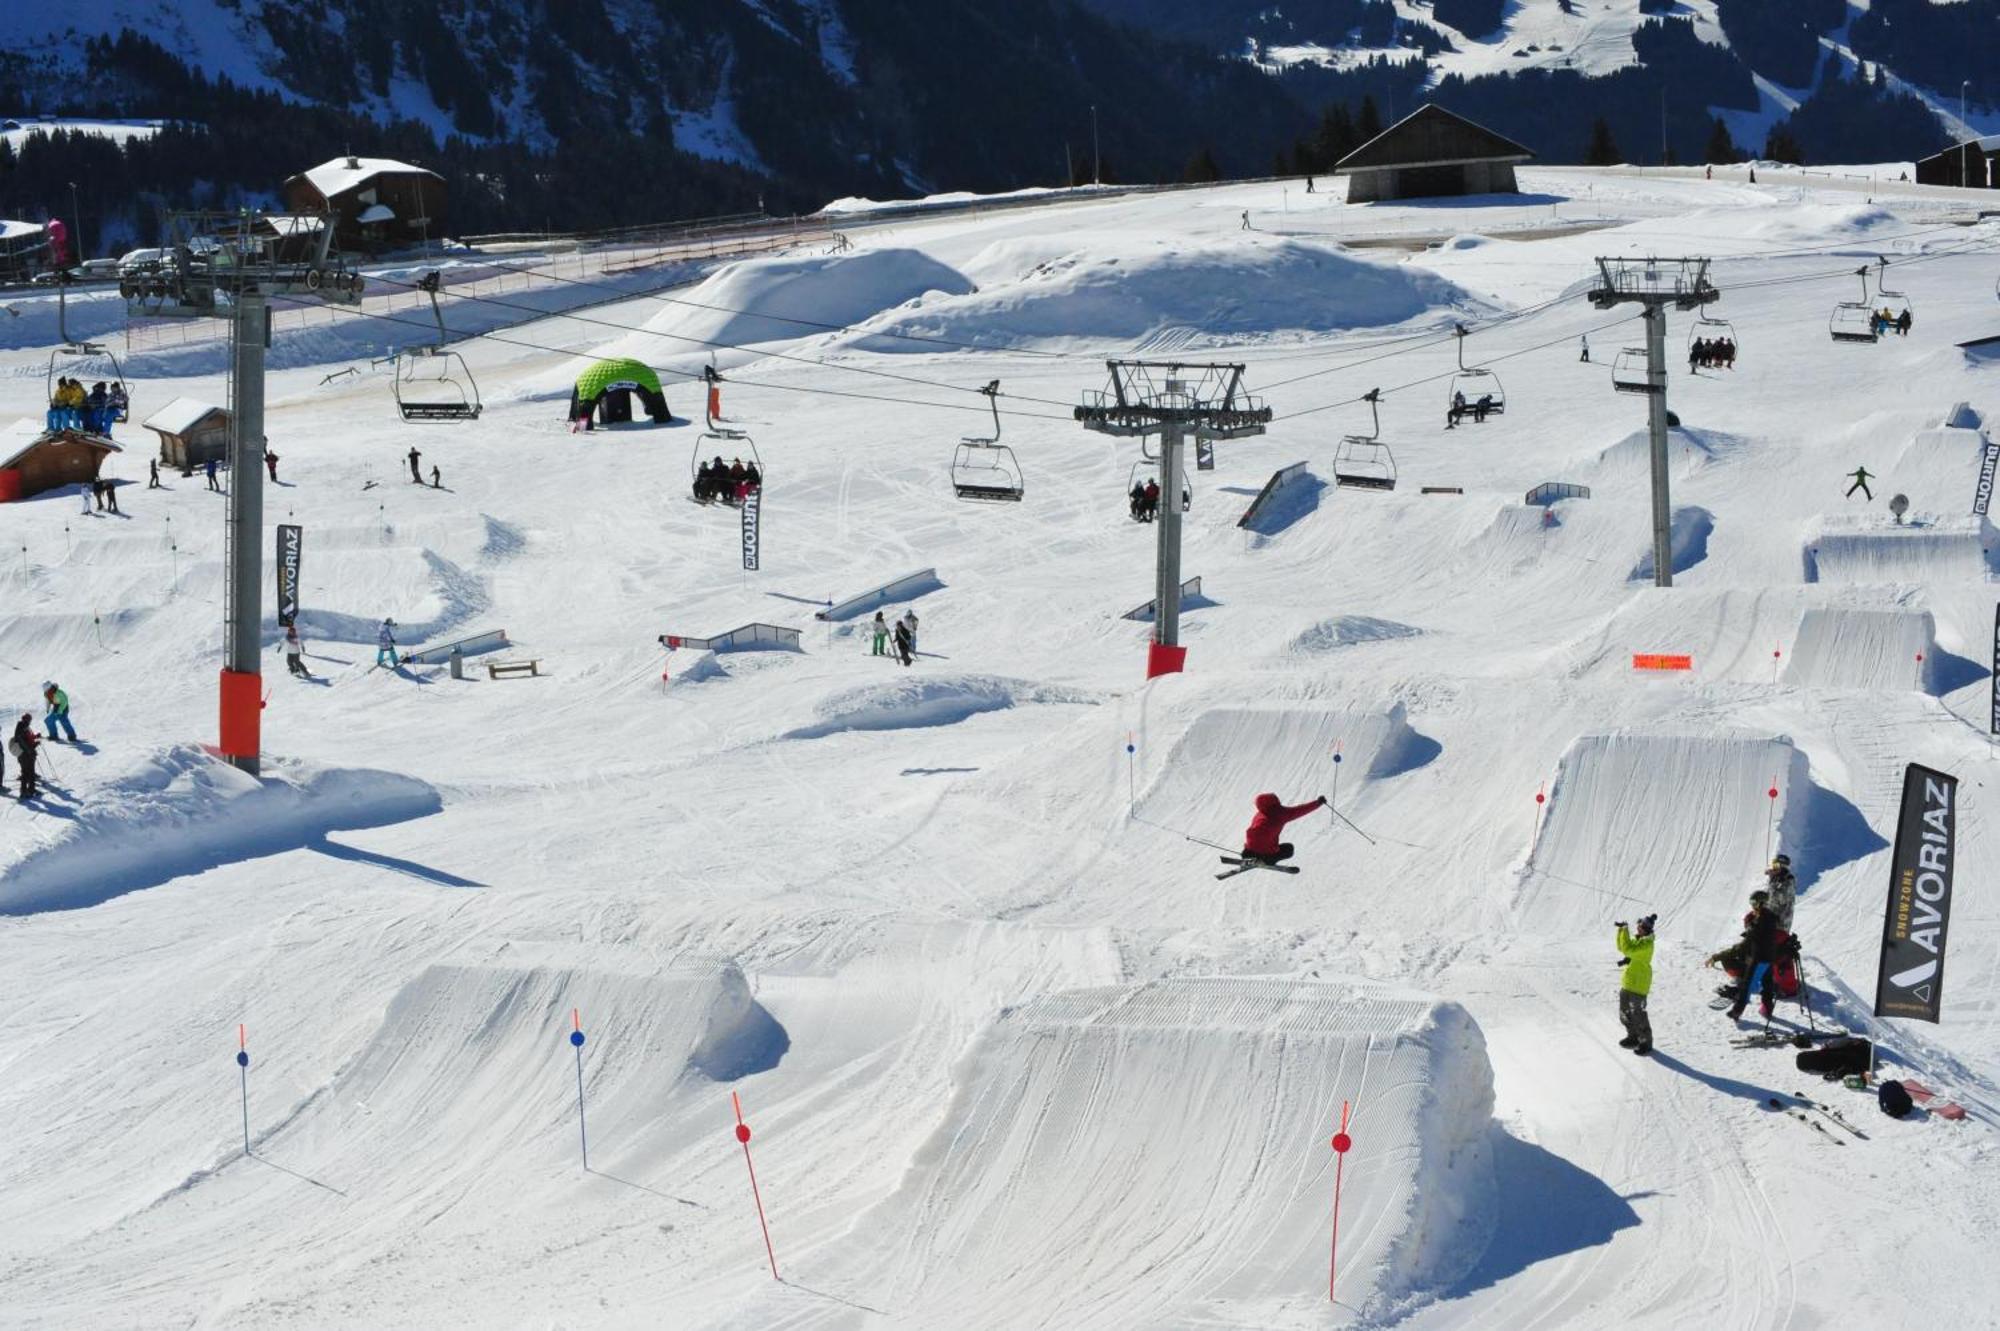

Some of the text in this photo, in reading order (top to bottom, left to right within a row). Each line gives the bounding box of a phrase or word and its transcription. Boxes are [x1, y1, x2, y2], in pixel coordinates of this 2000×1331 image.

[1978, 446, 1999, 501] BURTON
[286, 528, 298, 600] AVORIAZ
[1910, 777, 1949, 953] AVORIAZ
[1896, 868, 1914, 938] SNOWZONE
